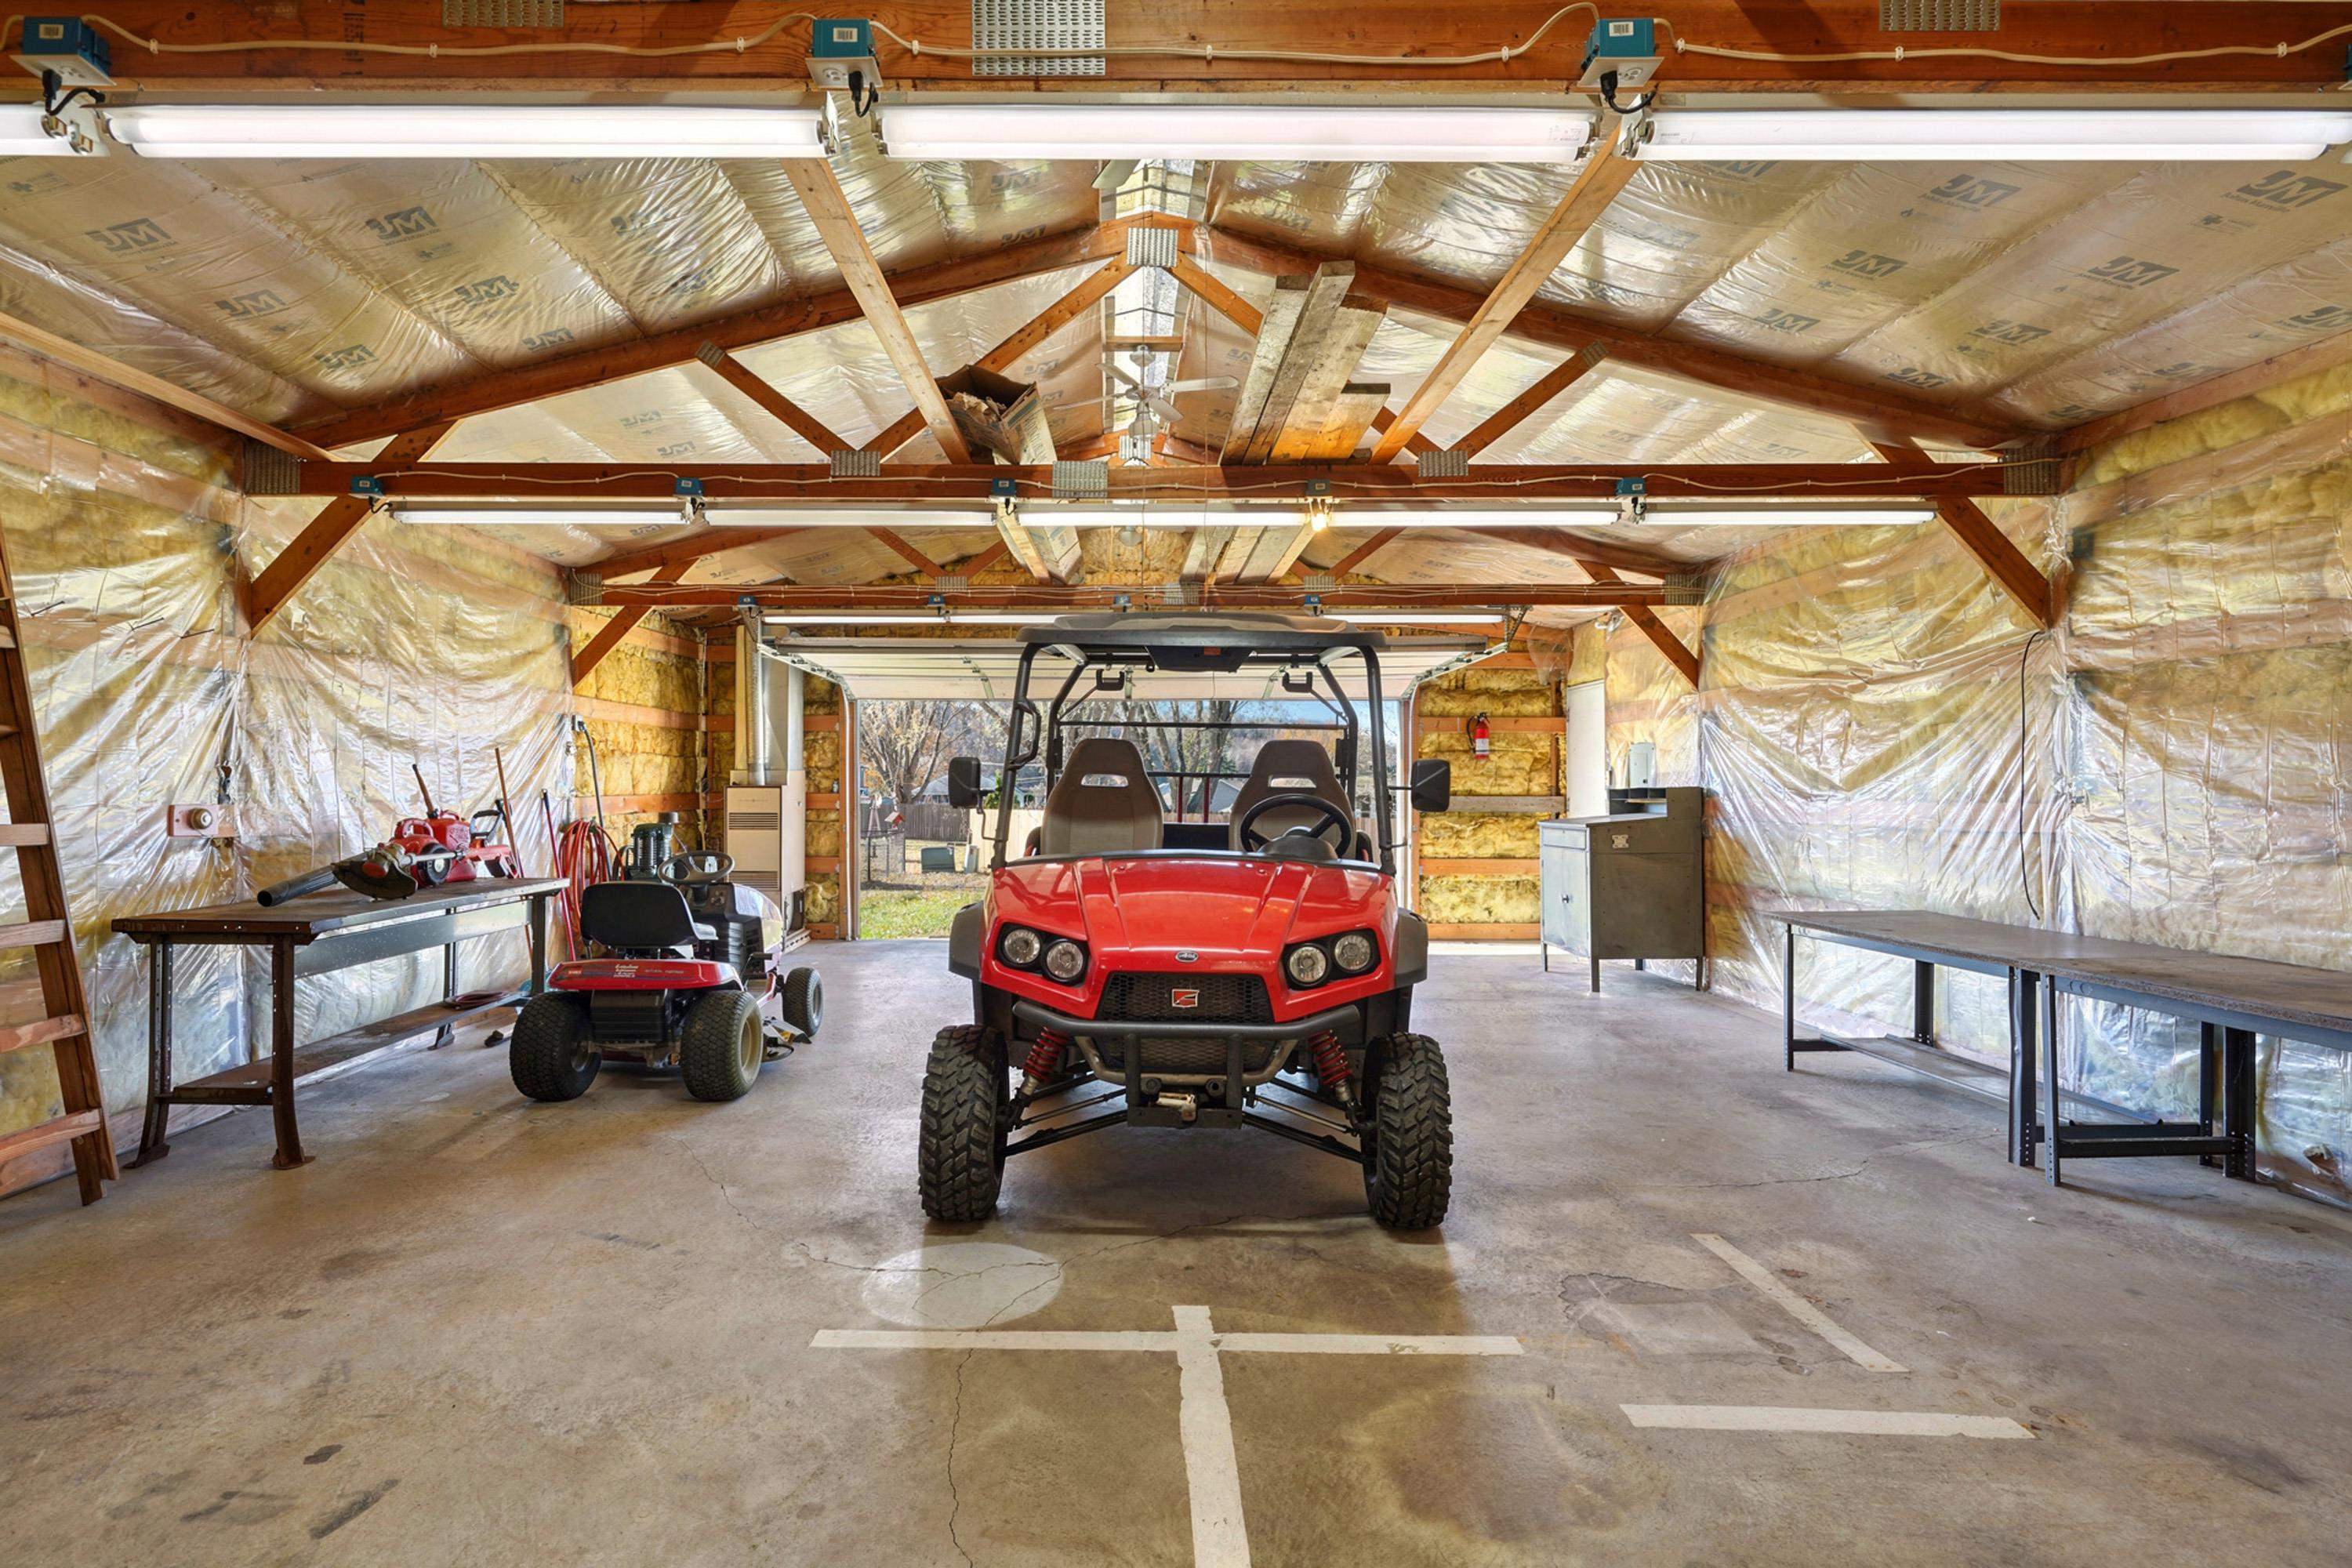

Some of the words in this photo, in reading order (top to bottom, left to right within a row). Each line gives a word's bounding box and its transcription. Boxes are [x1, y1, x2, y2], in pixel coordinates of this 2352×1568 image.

[1930, 173, 2022, 207] JM
[2237, 170, 2348, 208] JM
[85, 217, 172, 252] JM
[365, 205, 437, 240] JM
[1831, 249, 1908, 277] JM
[2087, 256, 2180, 285] JM
[214, 289, 288, 317] JM
[454, 275, 519, 304] JM
[1754, 308, 1820, 333] JM
[1975, 319, 2053, 343] JM
[522, 327, 575, 350] JM
[314, 343, 379, 372] JM
[1887, 367, 1952, 389] JM
